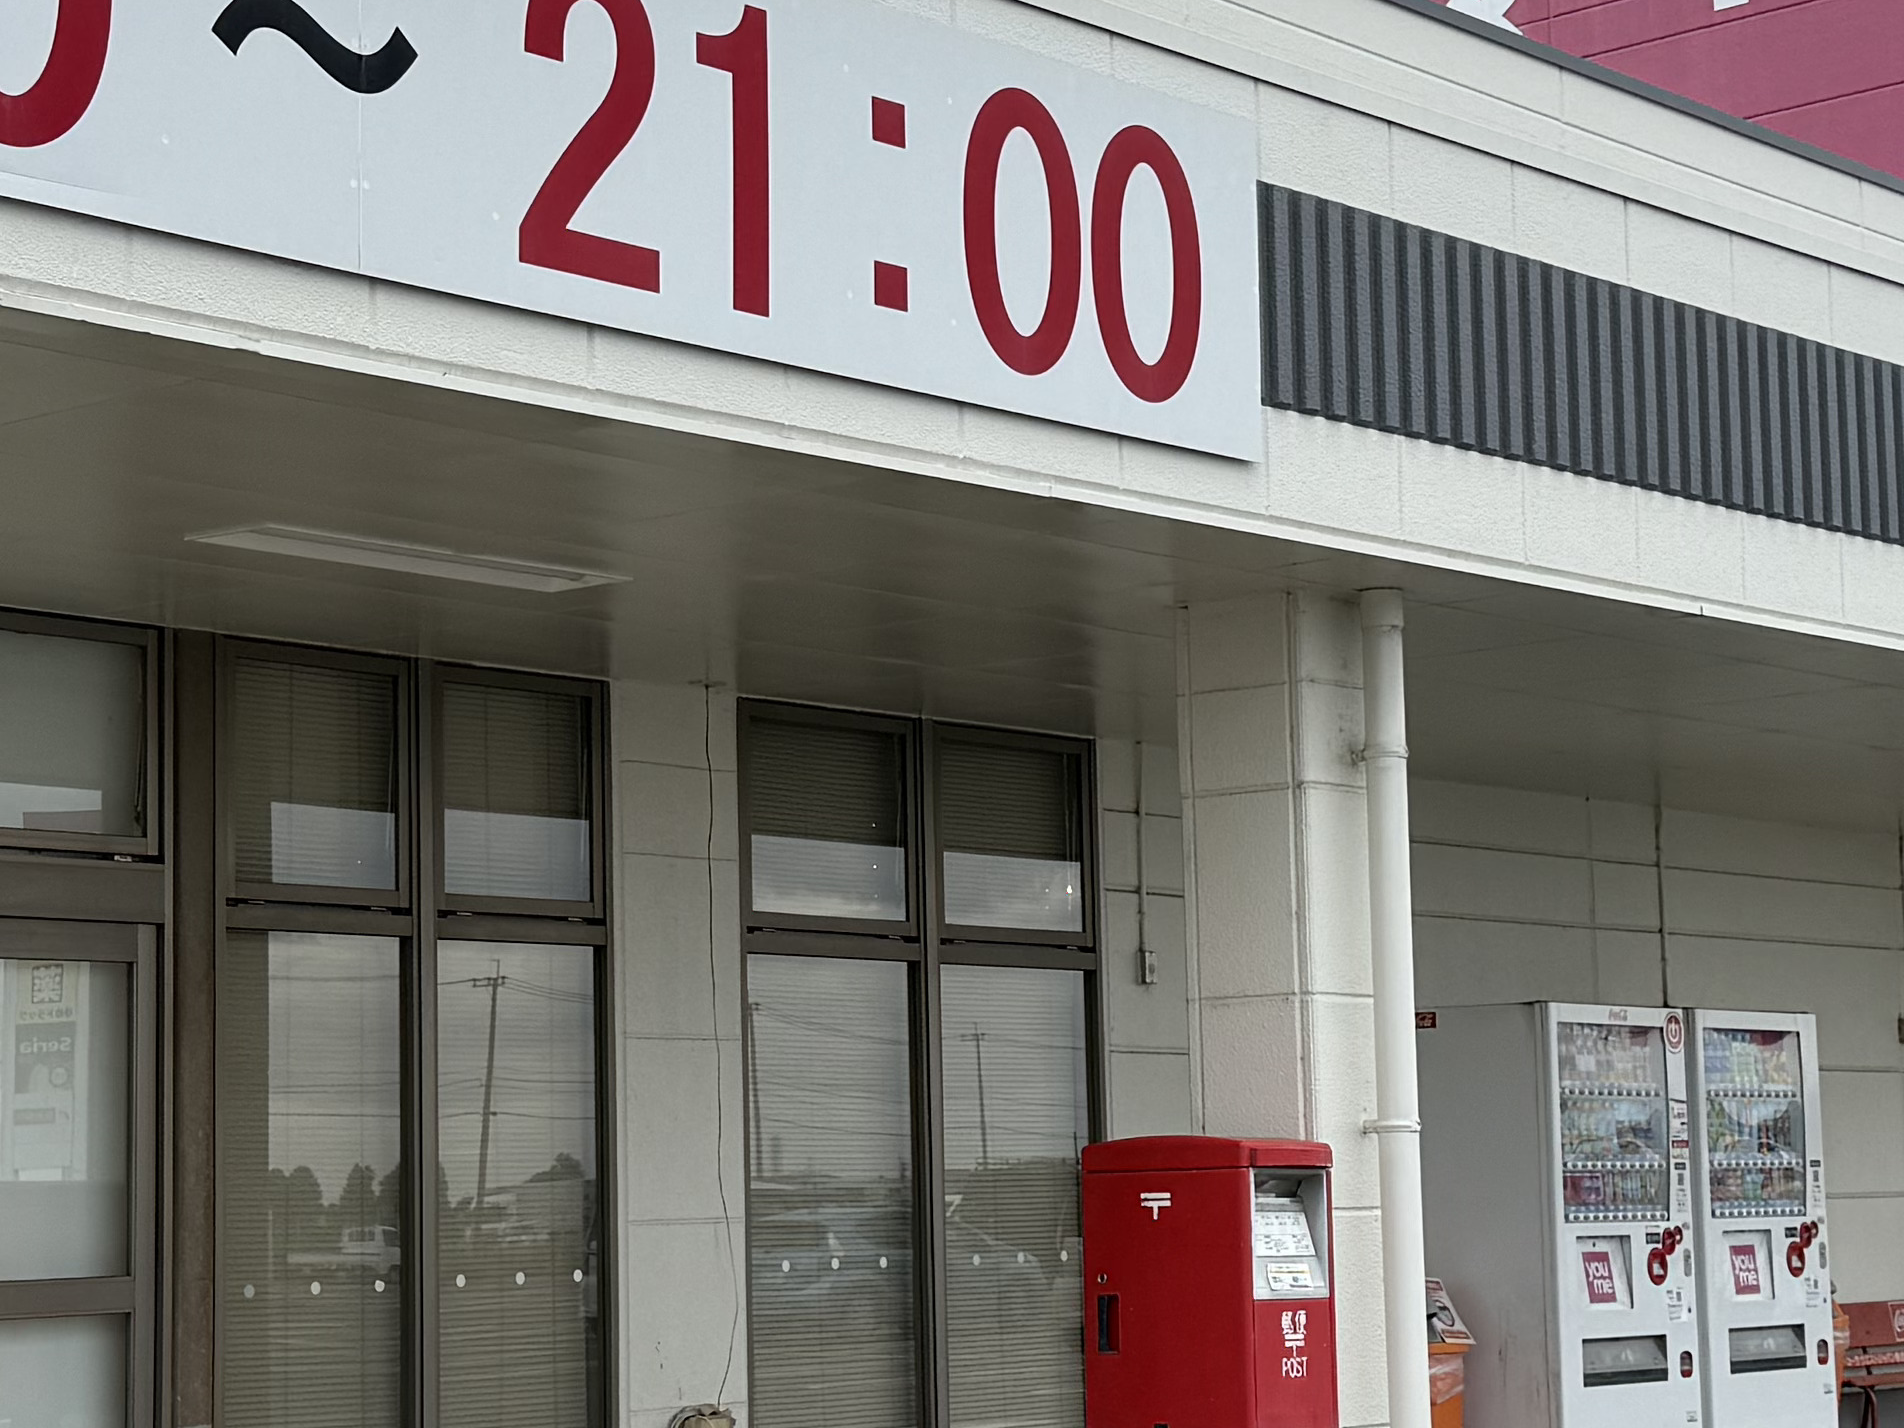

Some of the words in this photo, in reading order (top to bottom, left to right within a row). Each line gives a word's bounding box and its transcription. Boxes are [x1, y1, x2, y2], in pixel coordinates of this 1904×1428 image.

[1586, 1262, 1610, 1281] you
[1733, 1254, 1755, 1273] you
[1594, 1278, 1614, 1294] me
[1740, 1272, 1758, 1286] me
[1282, 1357, 1308, 1378] POST
